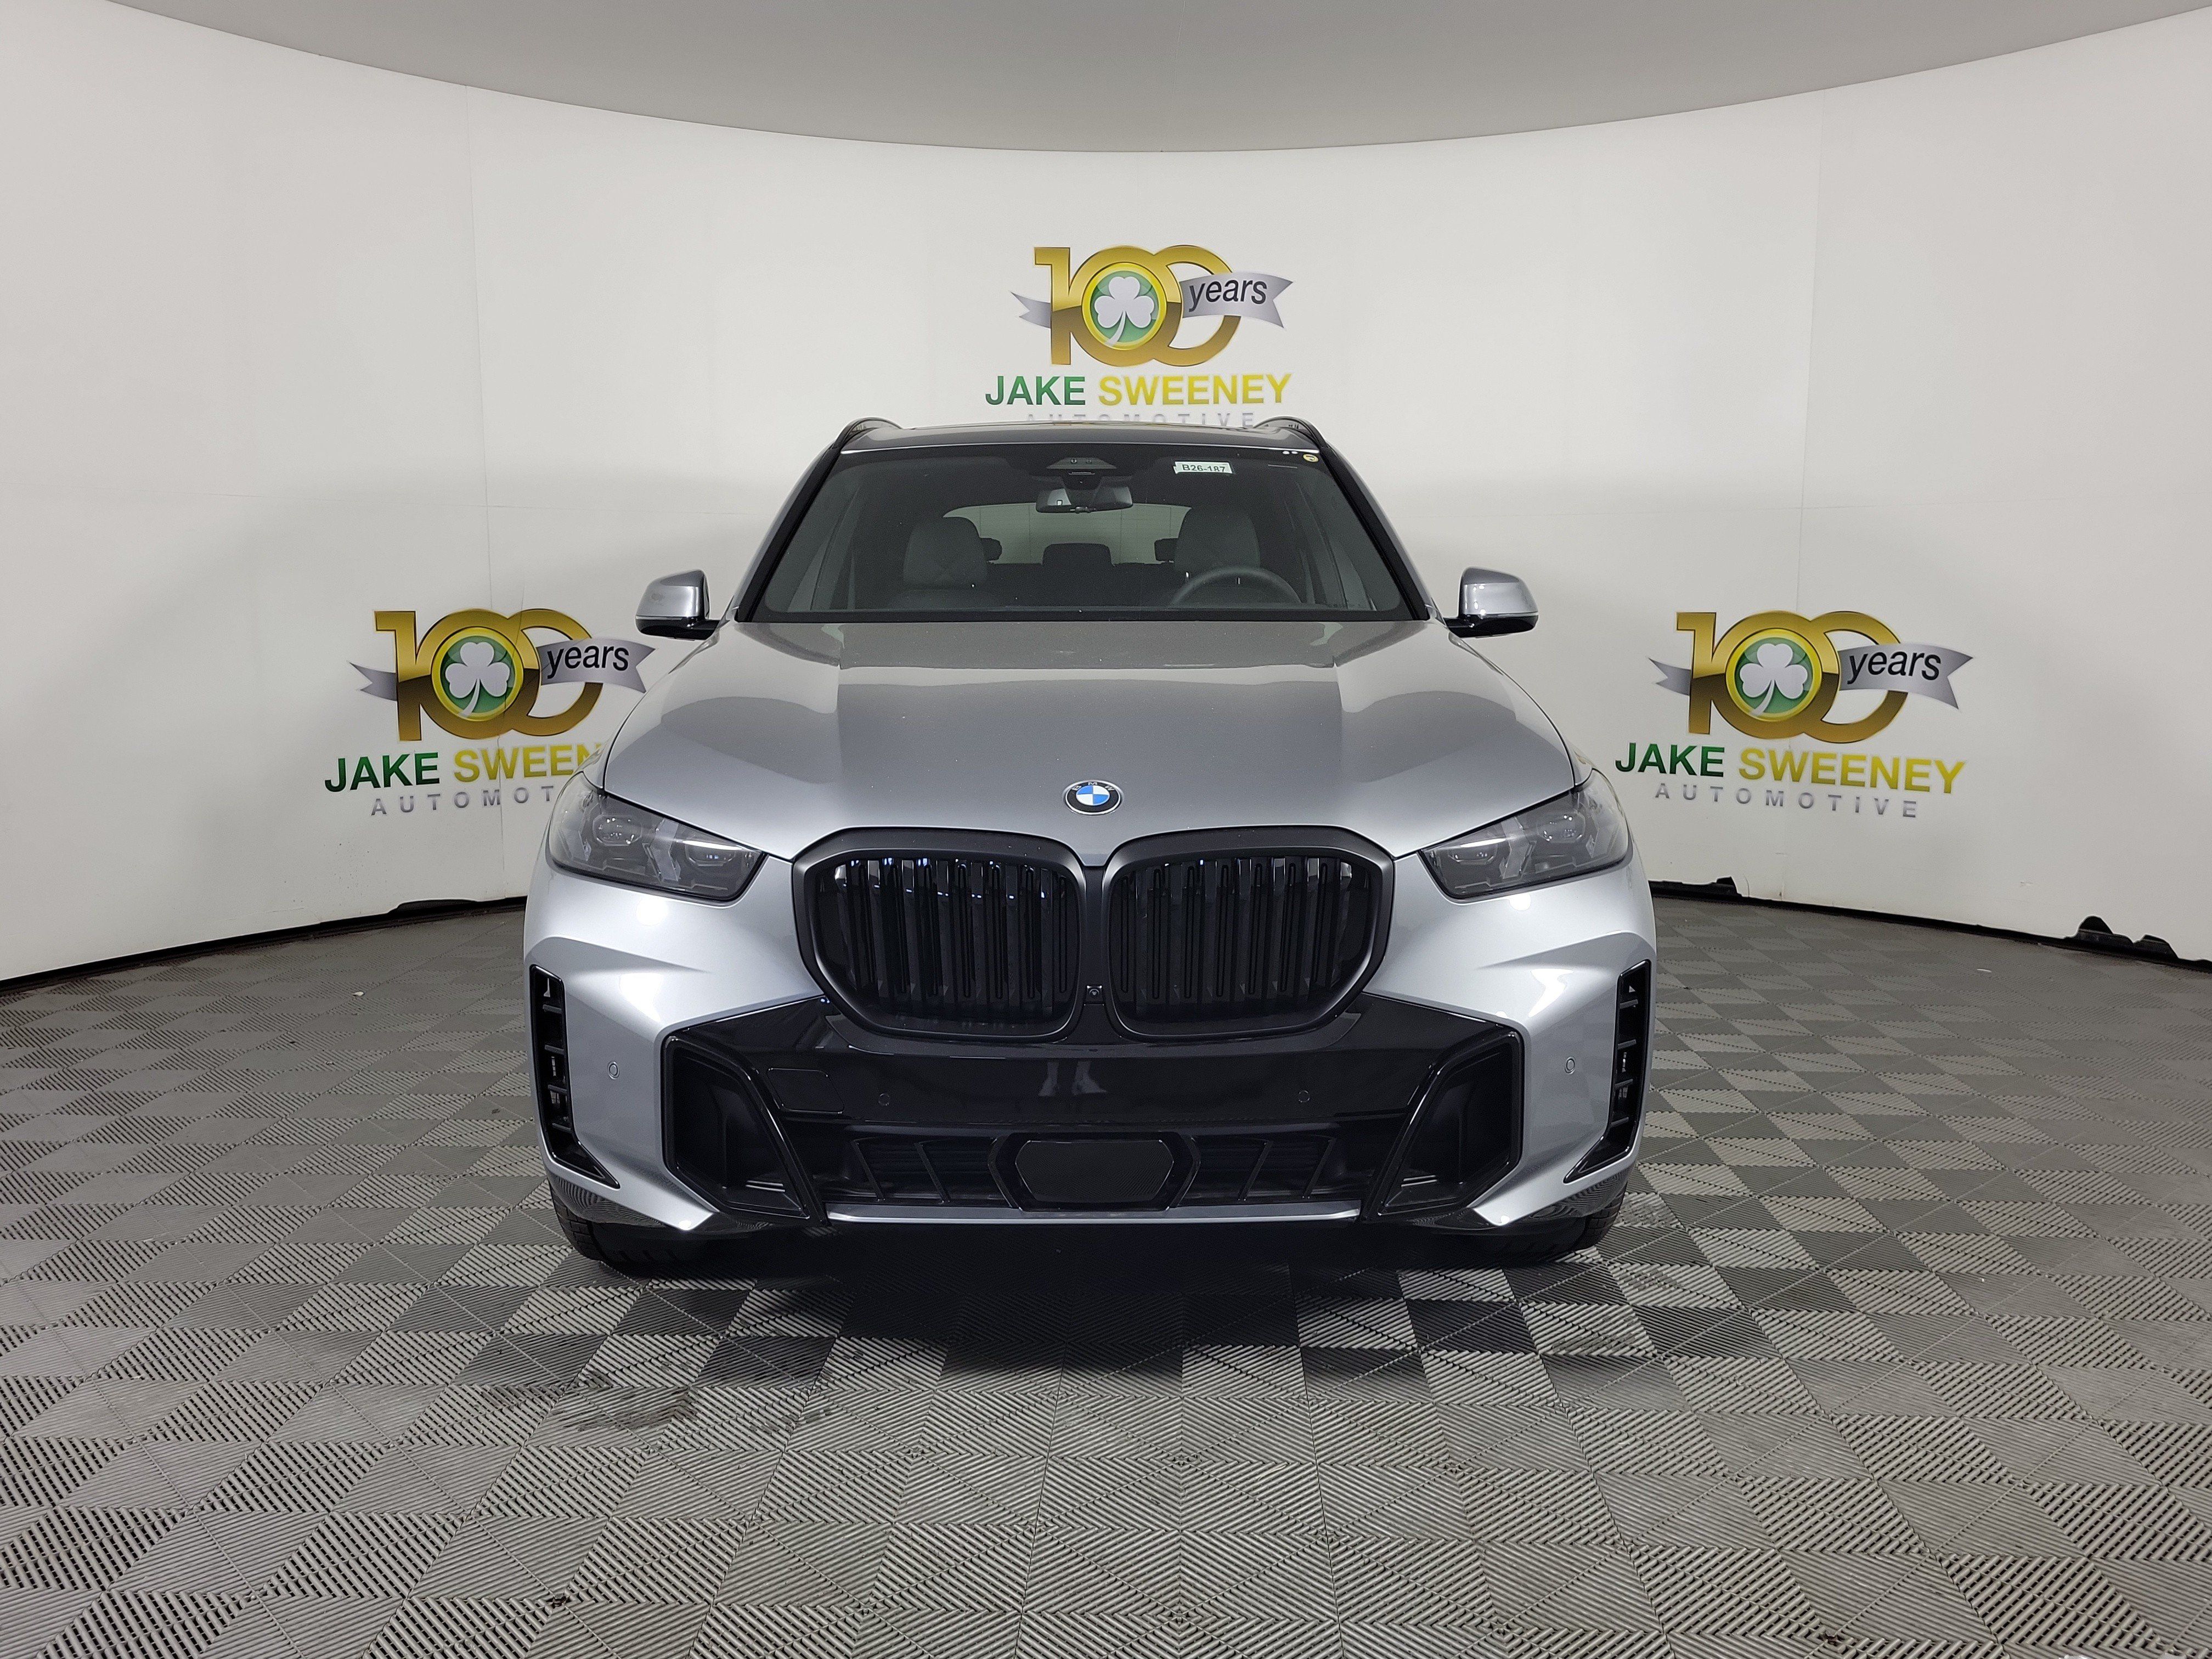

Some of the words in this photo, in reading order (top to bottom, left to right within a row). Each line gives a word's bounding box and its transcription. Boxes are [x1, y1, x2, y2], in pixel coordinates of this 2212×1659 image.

[1034, 245, 1242, 367] 100
[1188, 278, 1268, 312] years
[985, 375, 1086, 406] JAKE
[1098, 373, 1293, 406] SWEENEY
[1182, 464, 1226, 472] B26-187
[374, 608, 603, 741] 100
[547, 645, 629, 679] years
[1676, 610, 1908, 743] 100
[1847, 651, 1941, 685] years
[324, 752, 439, 792] JAKE
[454, 743, 602, 783] SWEE
[1071, 782, 1115, 791] BMW
[1615, 742, 1725, 778] JAKE
[1738, 747, 1966, 794] SWEENEY
[371, 785, 554, 816] AUTOMOT
[1655, 782, 1917, 818] AUTOMOTIVE
